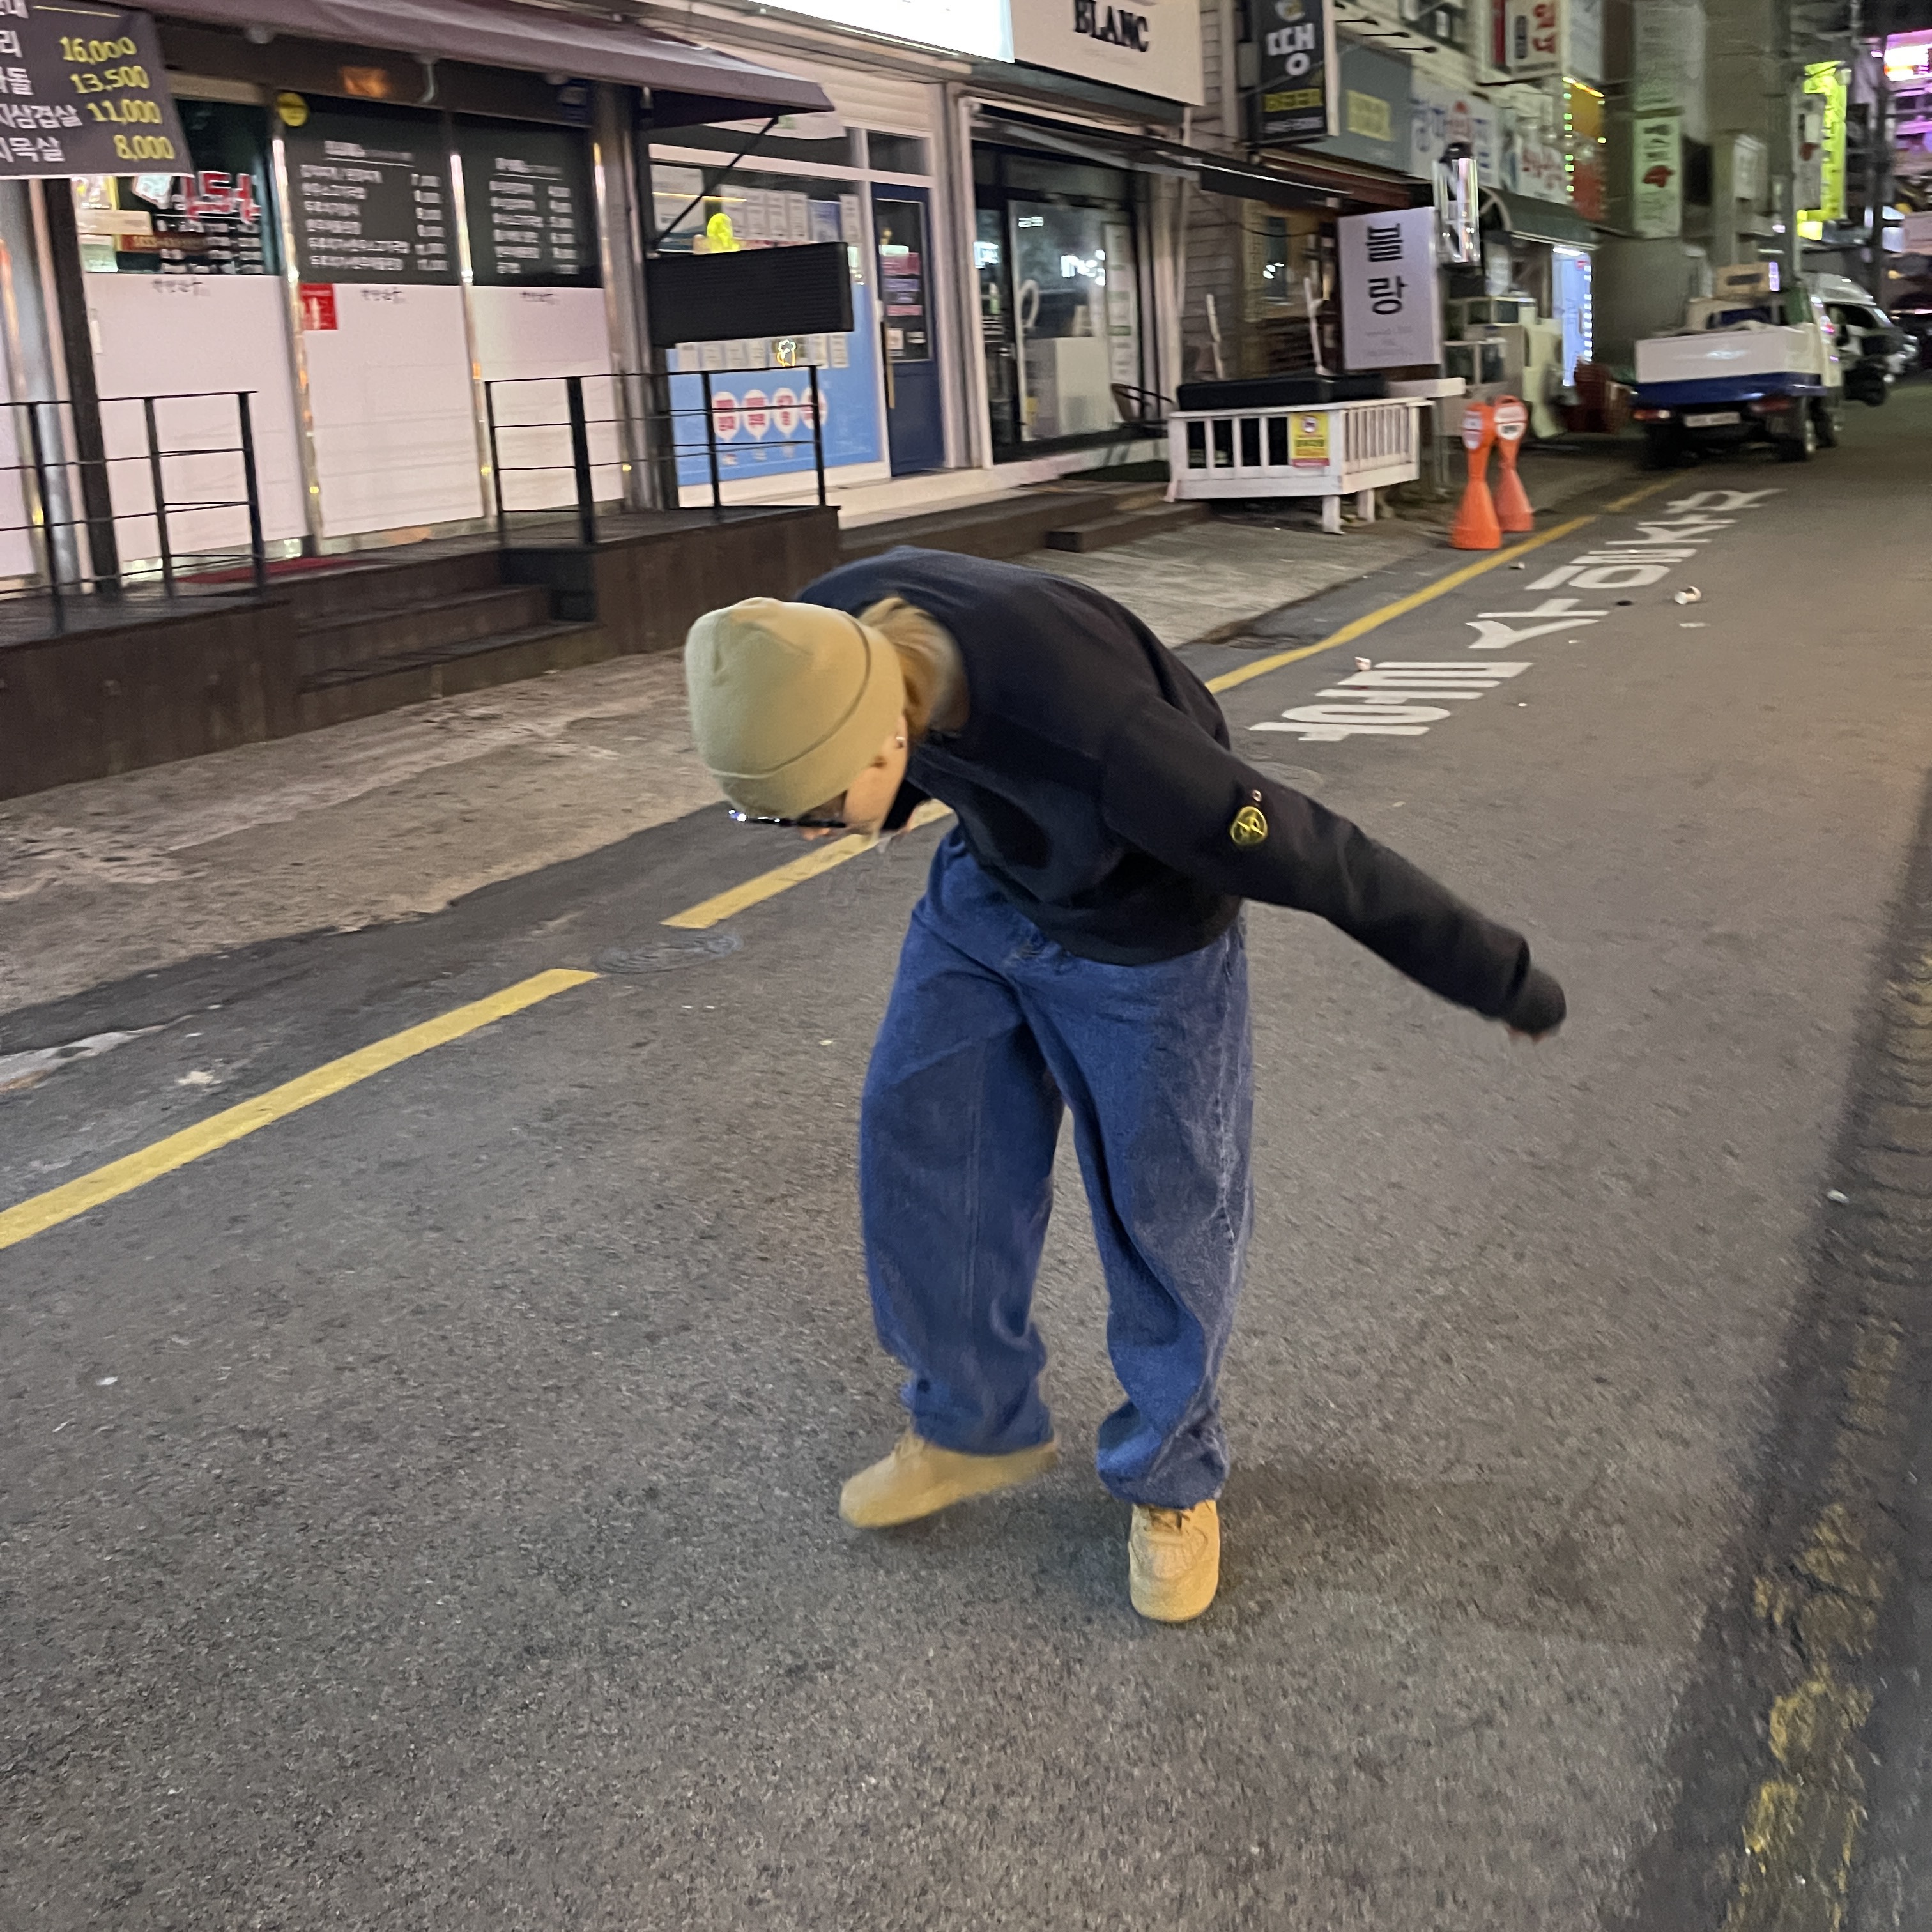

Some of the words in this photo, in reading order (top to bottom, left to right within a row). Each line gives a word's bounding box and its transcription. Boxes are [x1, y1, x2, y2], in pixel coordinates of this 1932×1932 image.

[1073, 0, 1149, 52] BLANC
[59, 36, 137, 64] 16,000
[70, 66, 150, 94] 13,500
[86, 98, 163, 125] 11,000
[113, 134, 175, 162] 8,000
[1365, 222, 1409, 315] 블랑
